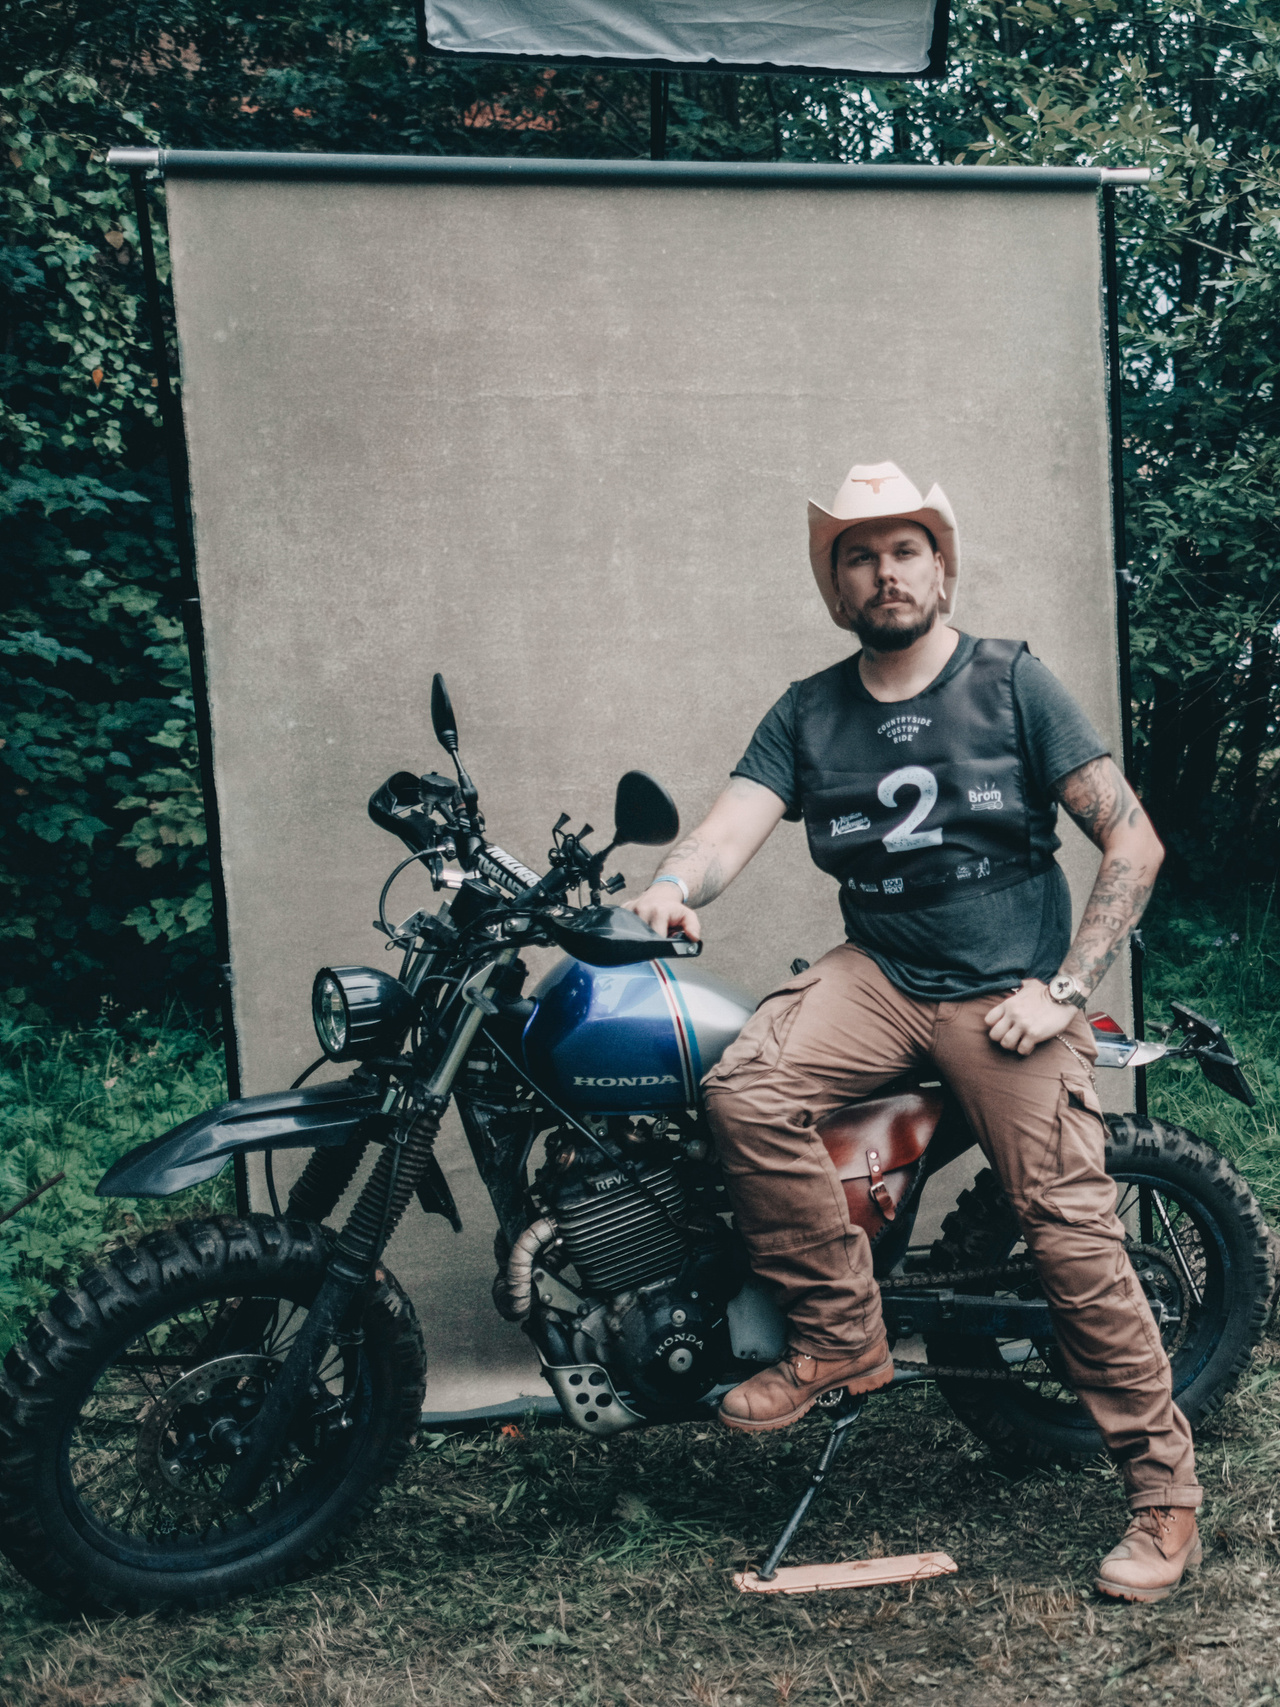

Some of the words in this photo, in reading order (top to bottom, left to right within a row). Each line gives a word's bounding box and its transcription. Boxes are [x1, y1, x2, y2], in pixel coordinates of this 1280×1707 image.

[877, 716, 932, 735] COUNTRYSIDE
[886, 725, 919, 738] CUSTOM
[893, 734, 913, 744] RIDE
[968, 790, 1001, 802] Brom
[878, 766, 943, 853] 2
[477, 853, 526, 894] ENTHAL
[884, 886, 903, 895] MOLY
[573, 1075, 680, 1087] HONDA
[655, 1333, 704, 1356] HONDA
